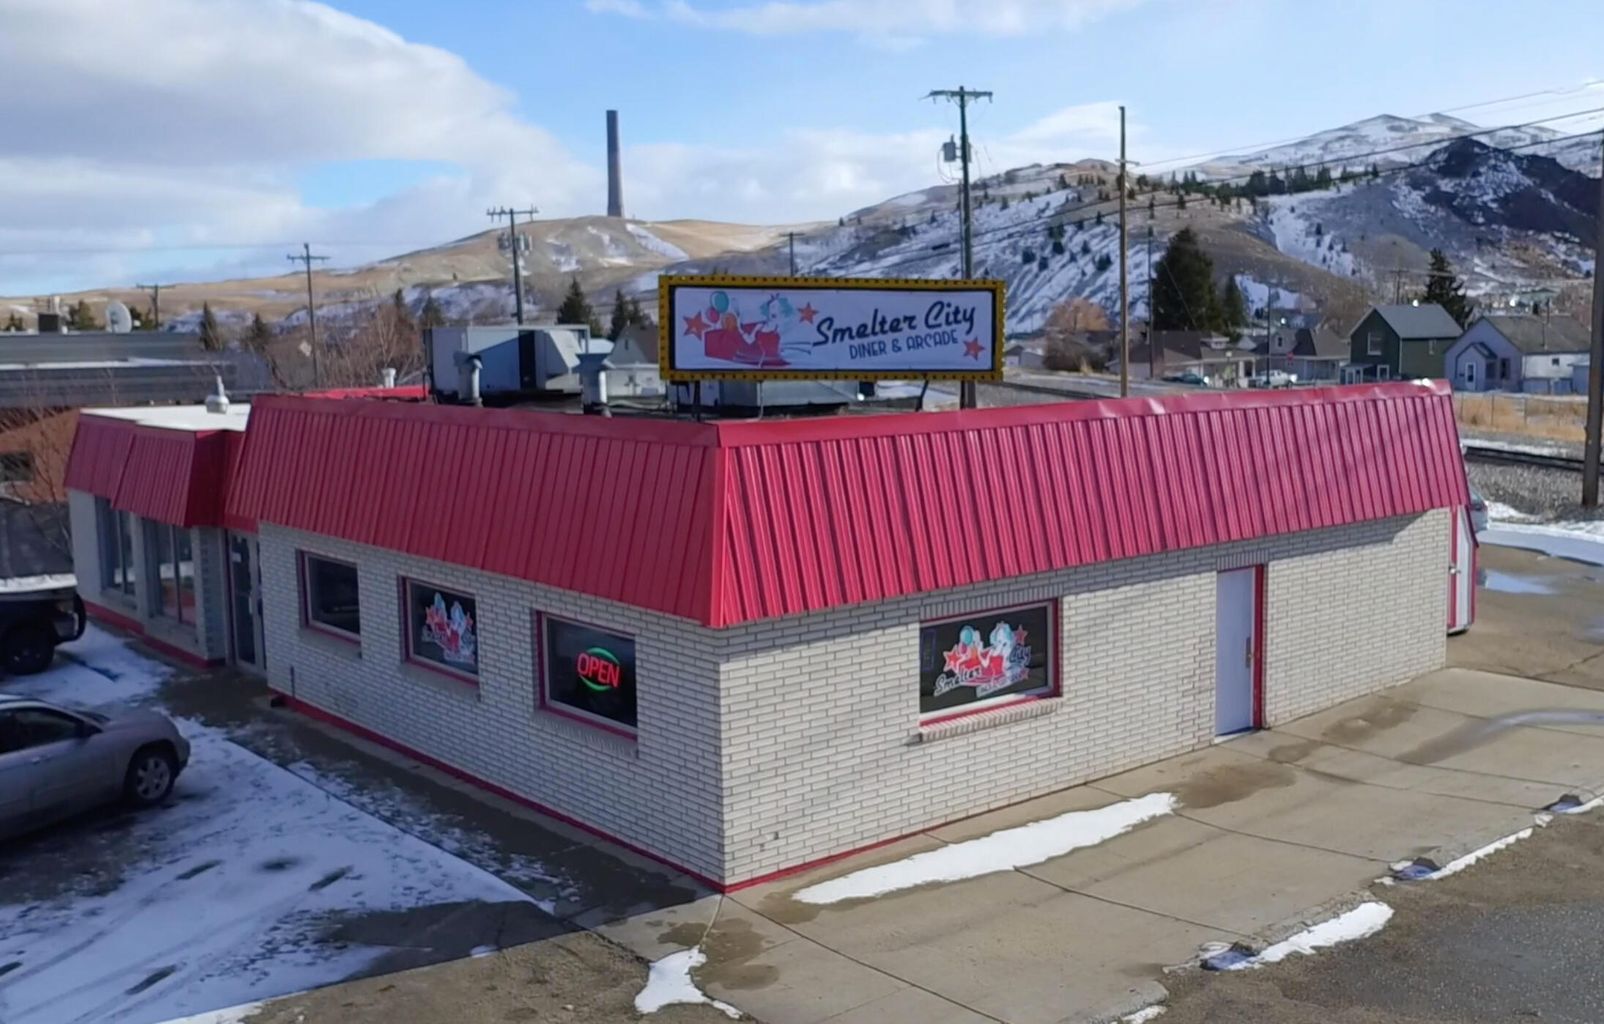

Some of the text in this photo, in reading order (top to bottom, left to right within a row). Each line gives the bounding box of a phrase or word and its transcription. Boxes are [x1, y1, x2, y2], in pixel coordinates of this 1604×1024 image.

[812, 300, 976, 347] Smelter City
[849, 330, 958, 360] DINER & ARCADE
[577, 652, 620, 688] OPEN
